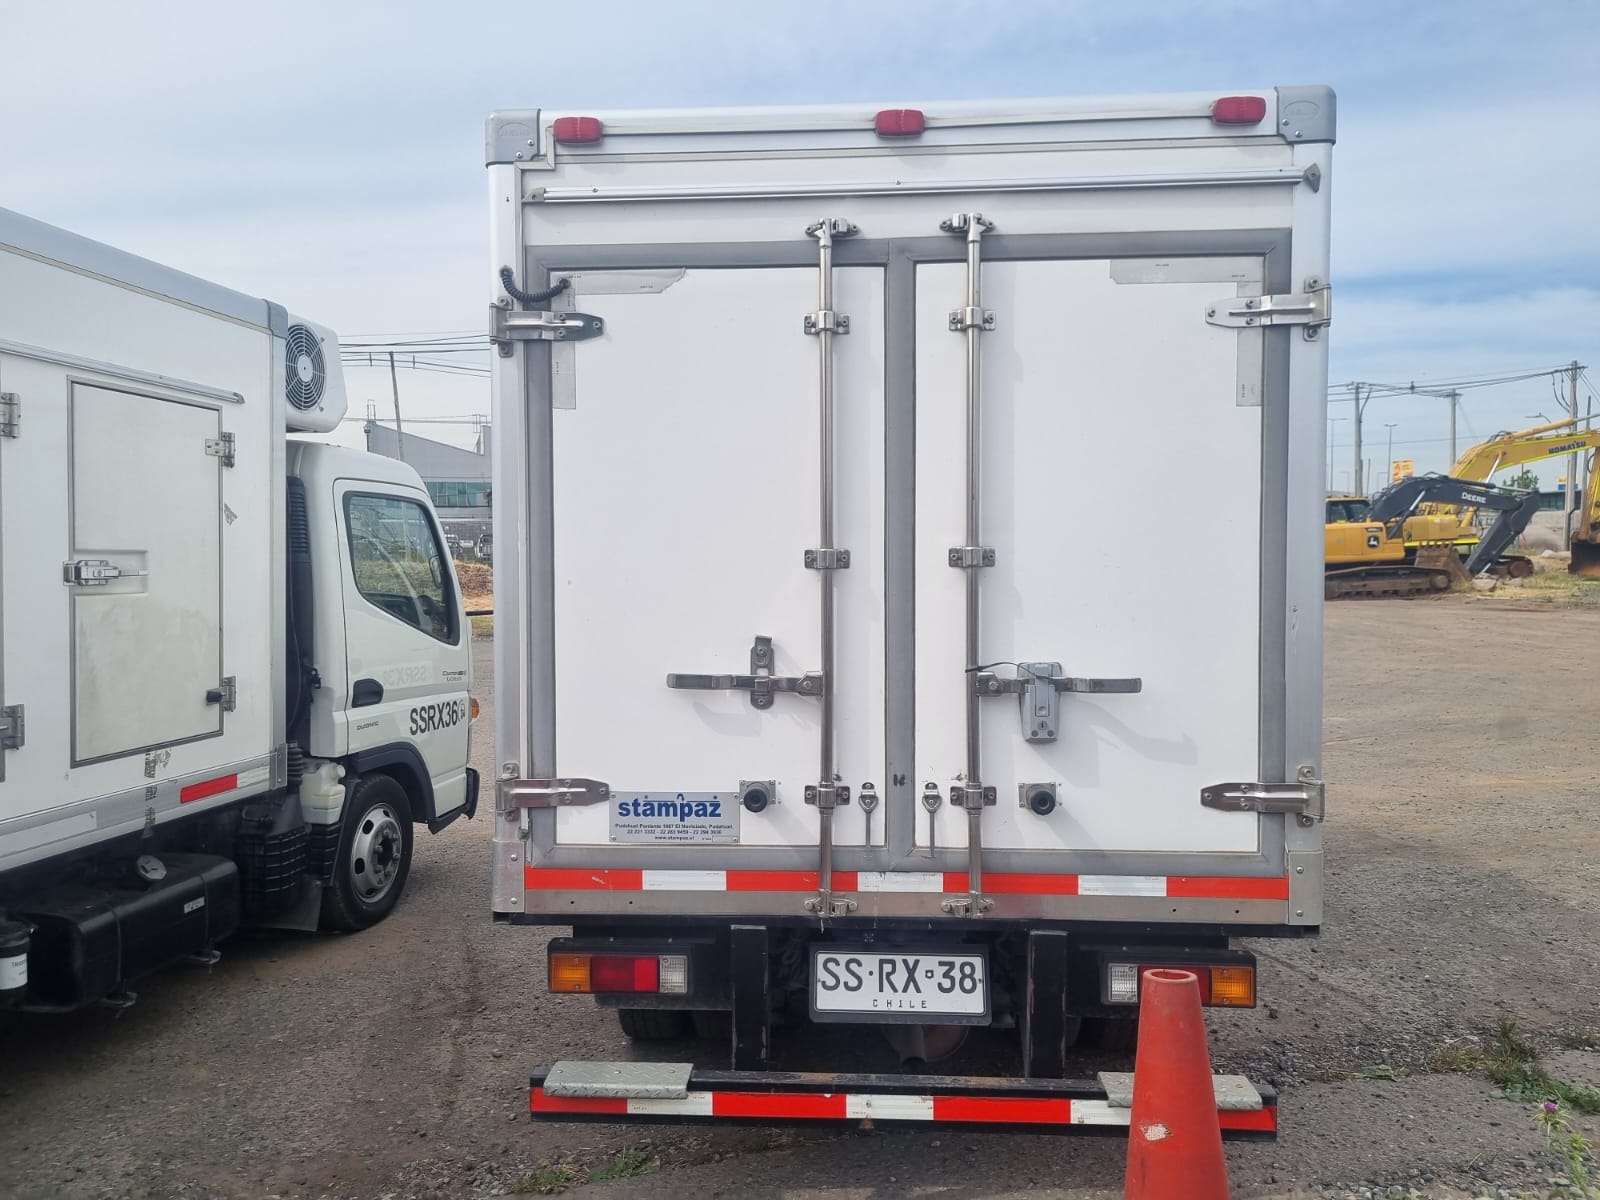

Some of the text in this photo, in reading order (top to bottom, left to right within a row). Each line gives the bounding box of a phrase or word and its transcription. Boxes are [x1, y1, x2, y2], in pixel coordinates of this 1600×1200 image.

[1548, 440, 1586, 454] KOMATSU
[1461, 491, 1487, 504] DEERE
[409, 700, 458, 736] SSRX36
[618, 797, 722, 822] stampaz
[872, 999, 927, 1009] CHILE
